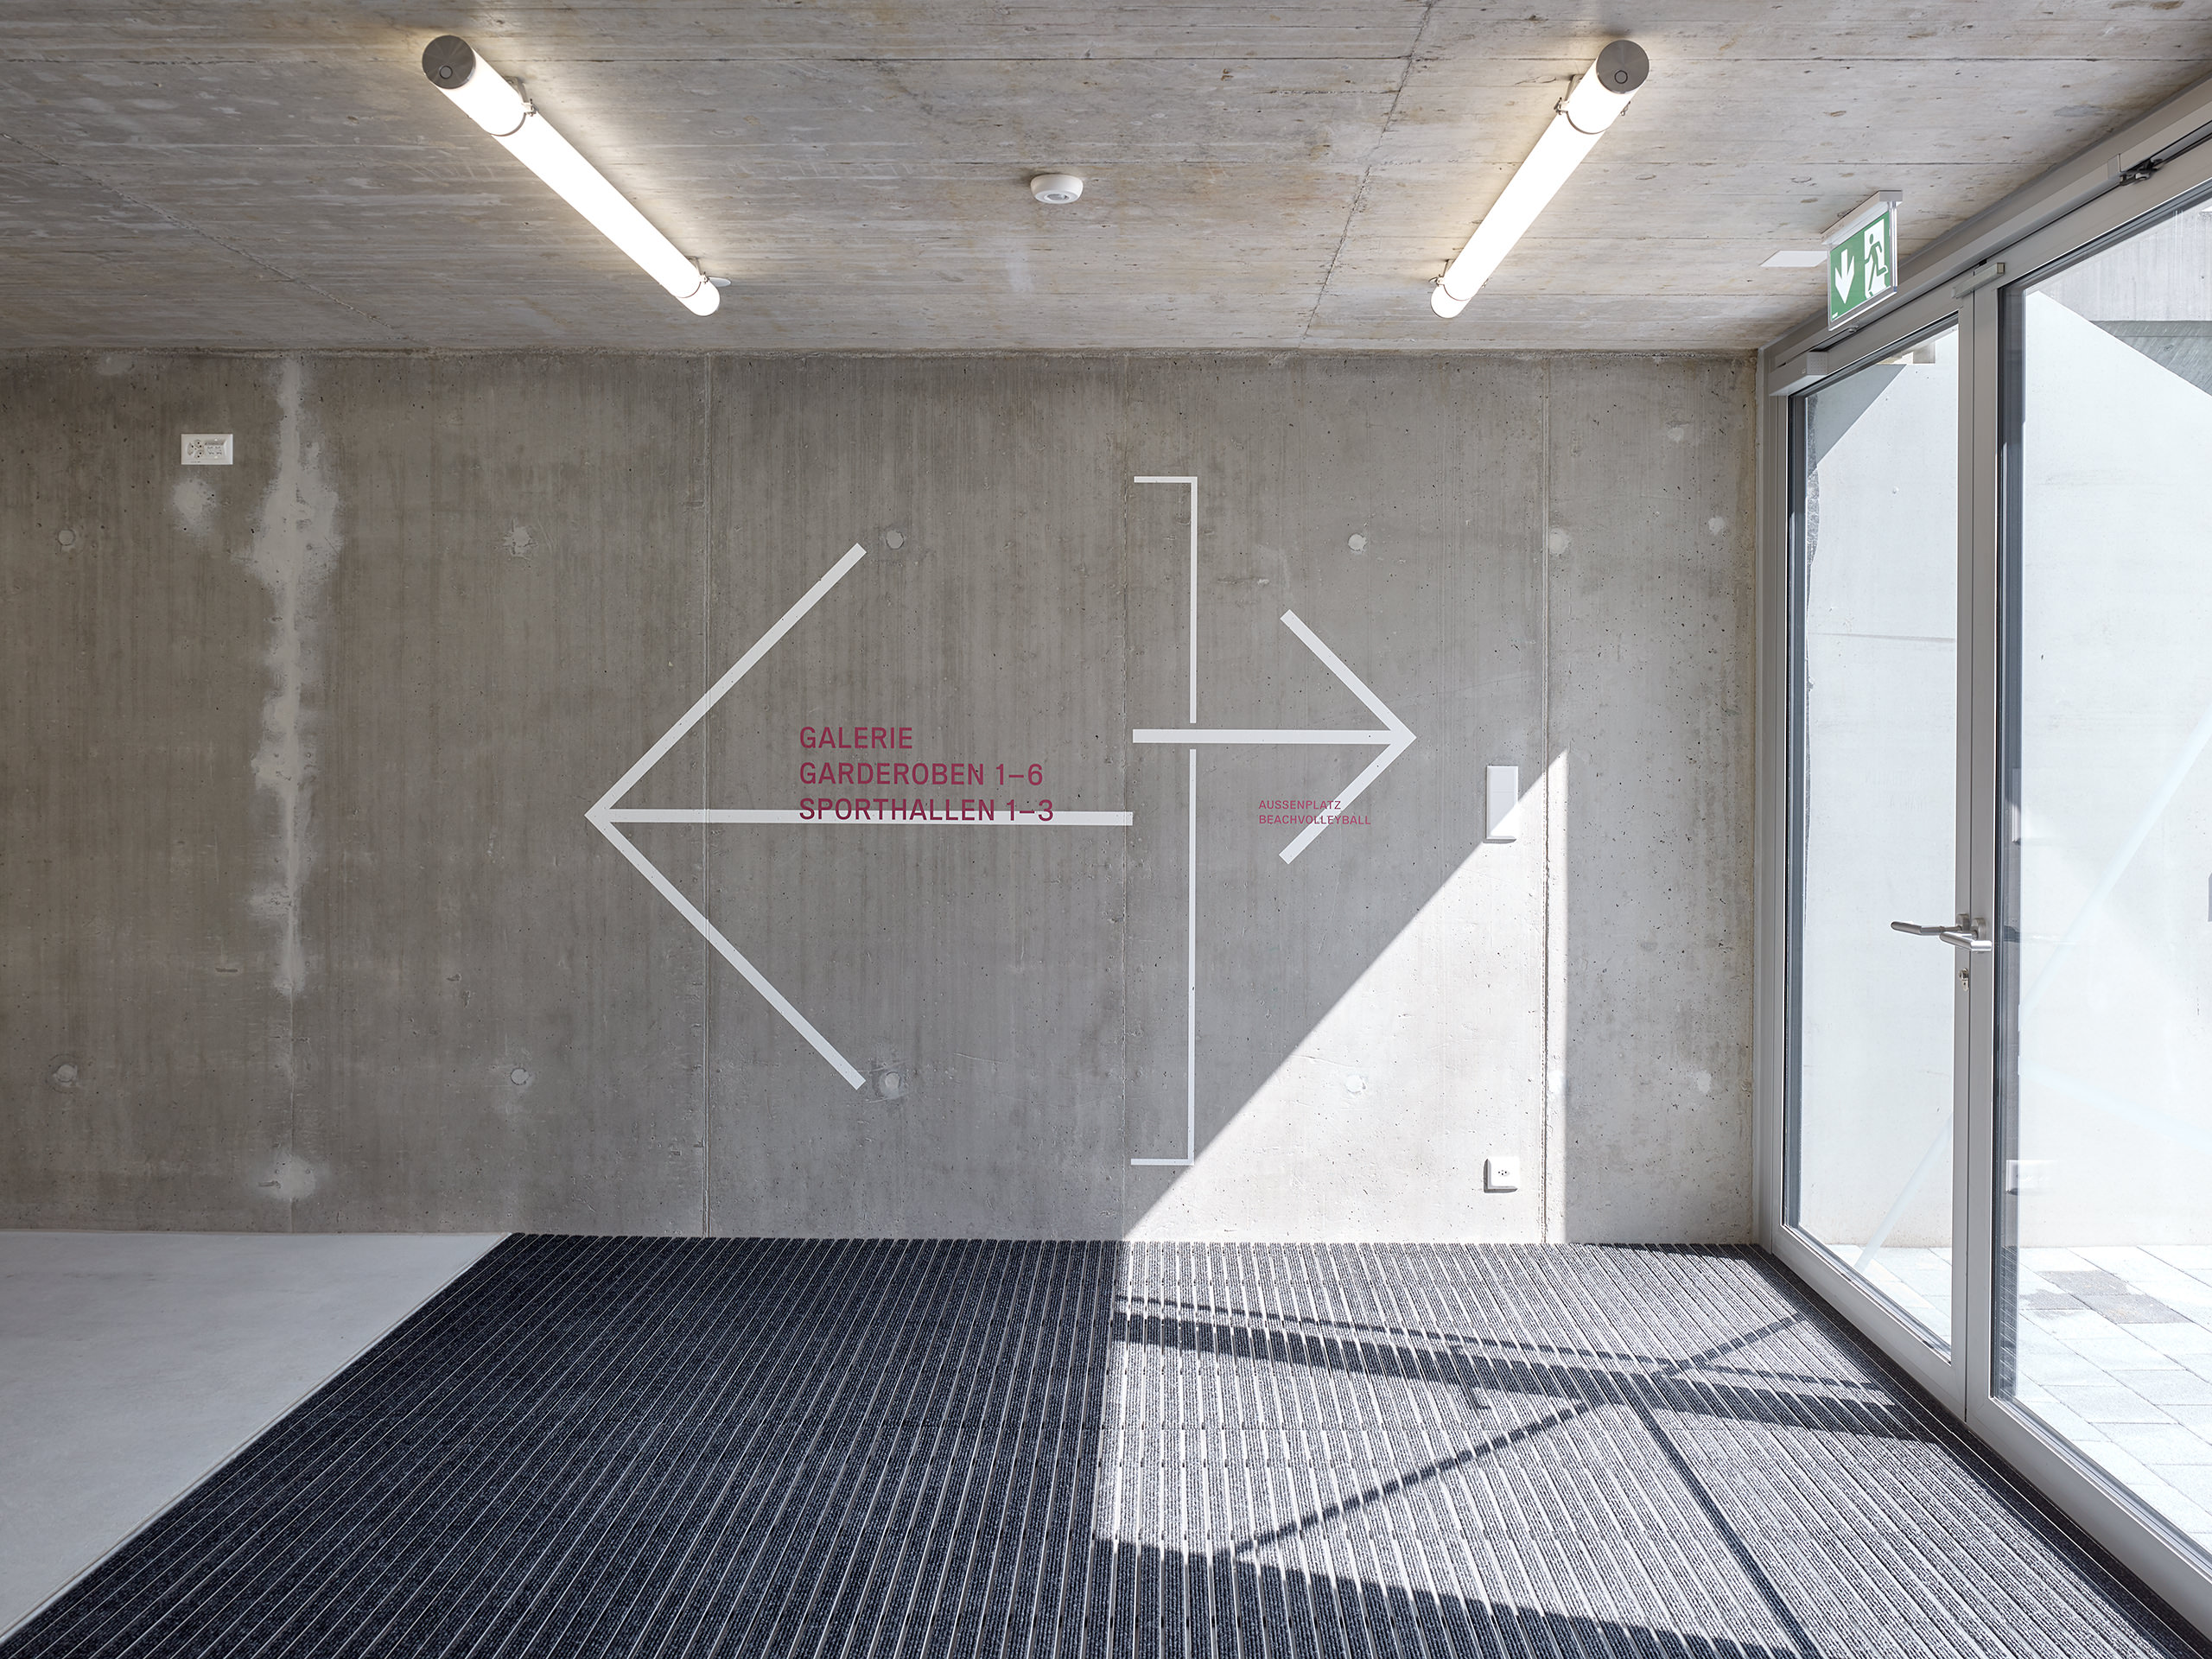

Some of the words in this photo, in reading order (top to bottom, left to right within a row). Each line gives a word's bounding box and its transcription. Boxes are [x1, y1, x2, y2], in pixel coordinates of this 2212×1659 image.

[799, 727, 912, 749] GALERIE
[799, 762, 984, 785] GARDEROBEN
[799, 798, 995, 821] SPORTHALLEN
[1258, 799, 1341, 810] AUSSENPLATZ
[1259, 815, 1371, 825] BEACHVOLLEYBALL
